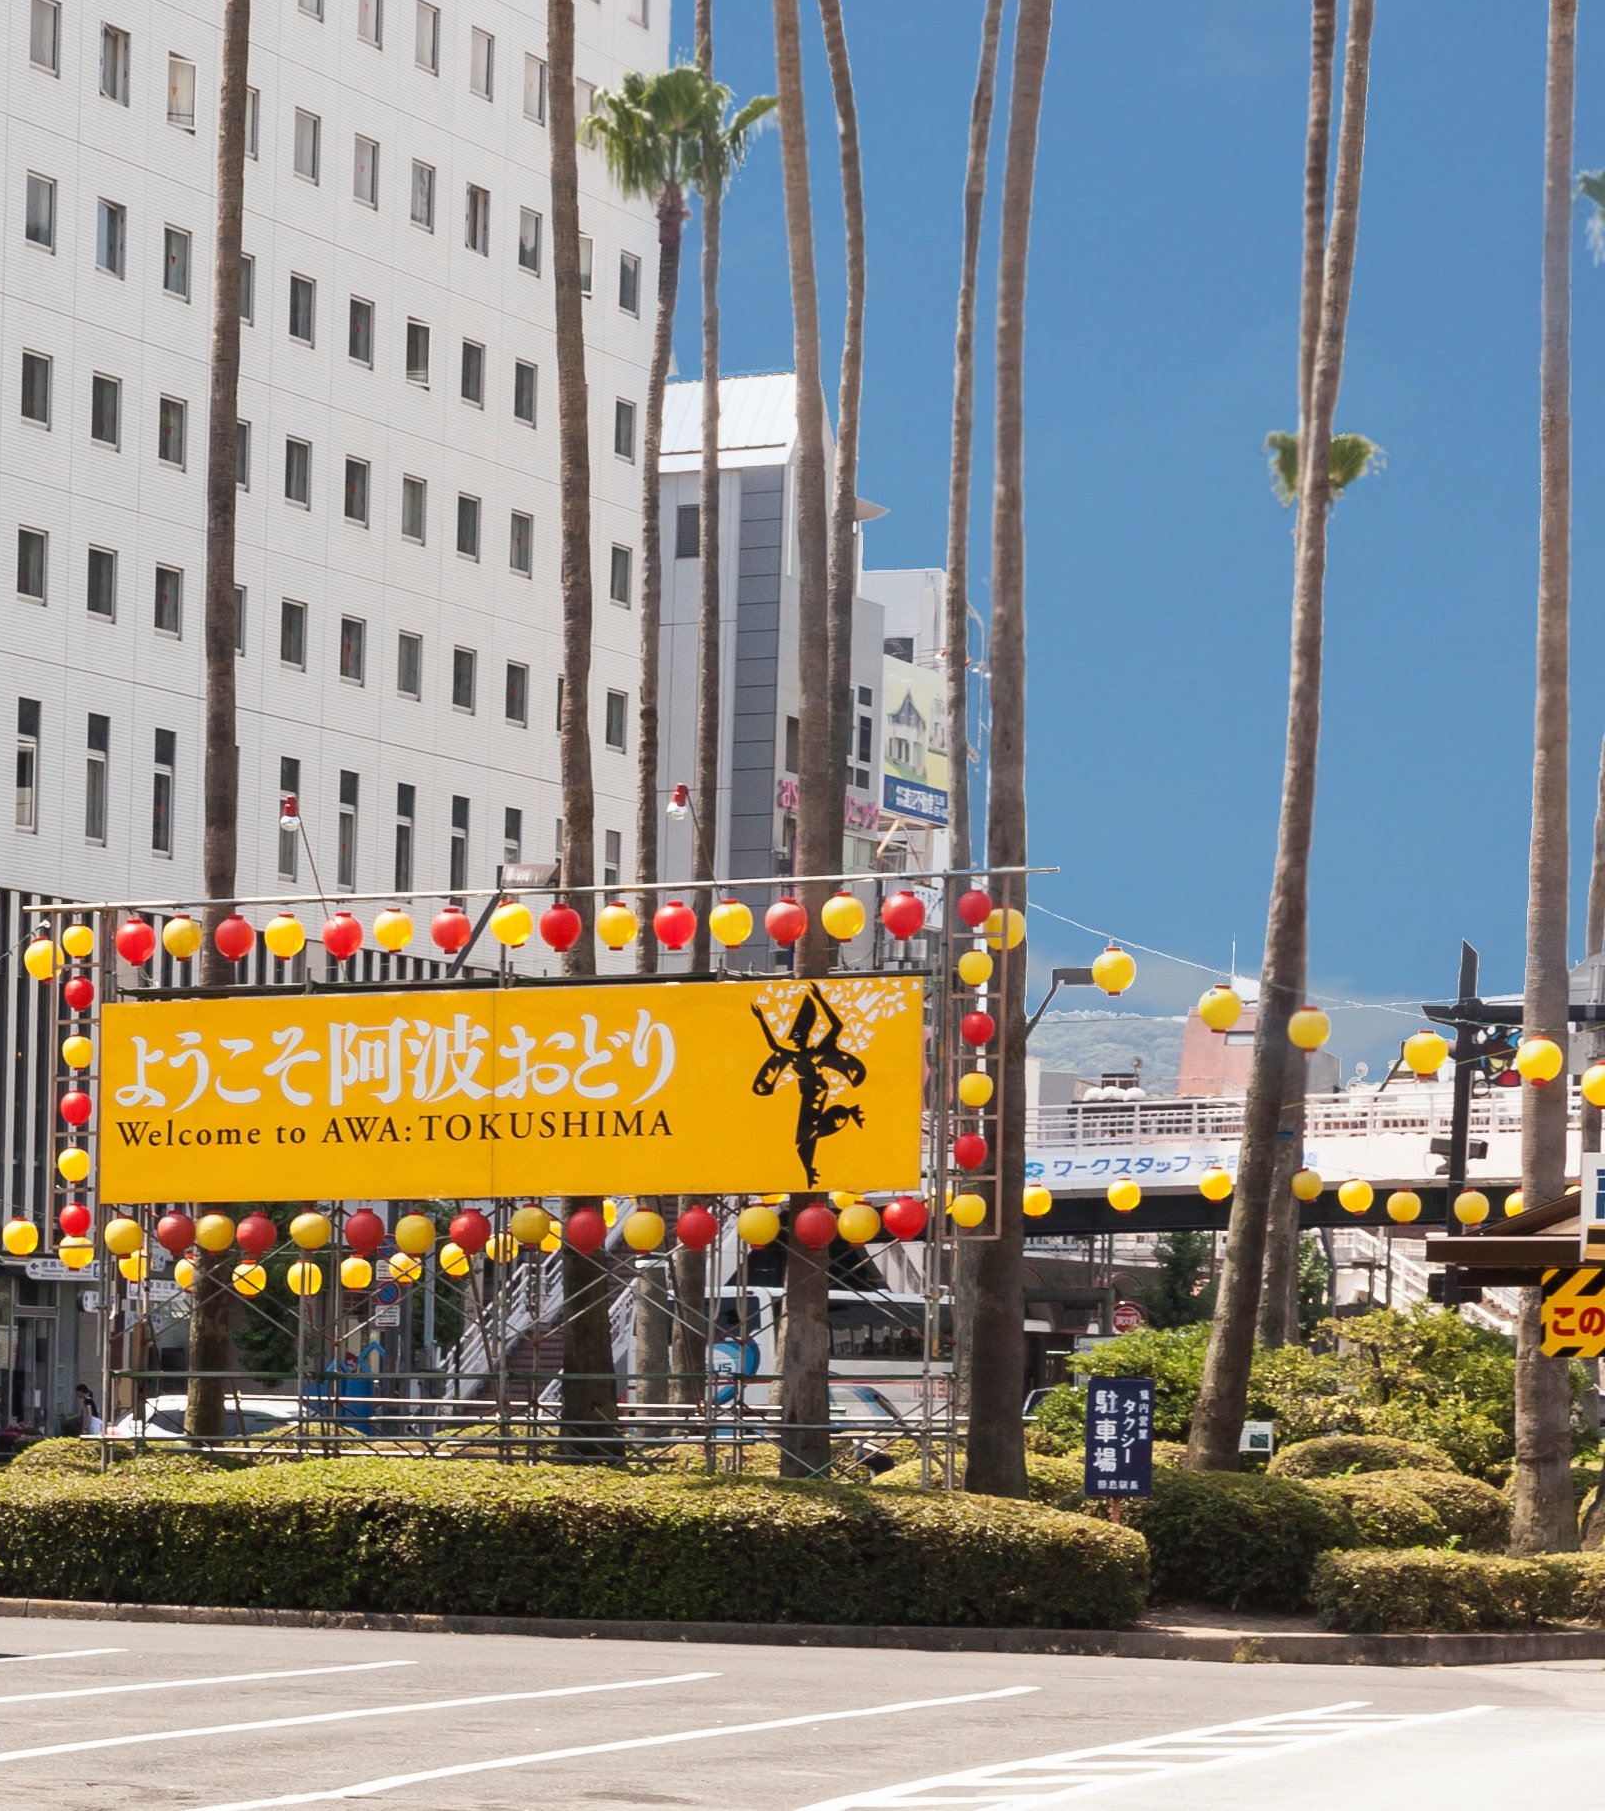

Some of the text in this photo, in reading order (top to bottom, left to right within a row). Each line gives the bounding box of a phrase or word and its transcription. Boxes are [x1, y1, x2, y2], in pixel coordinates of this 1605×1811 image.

[117, 1108, 675, 1147] Welcome to AWA:TOKUSHIMA
[1053, 1156, 1190, 1176] ワークスタッフ
[1552, 1307, 1605, 1337] この
[1093, 1390, 1118, 1472] 駐車場
[1121, 1399, 1136, 1463] タクシー
